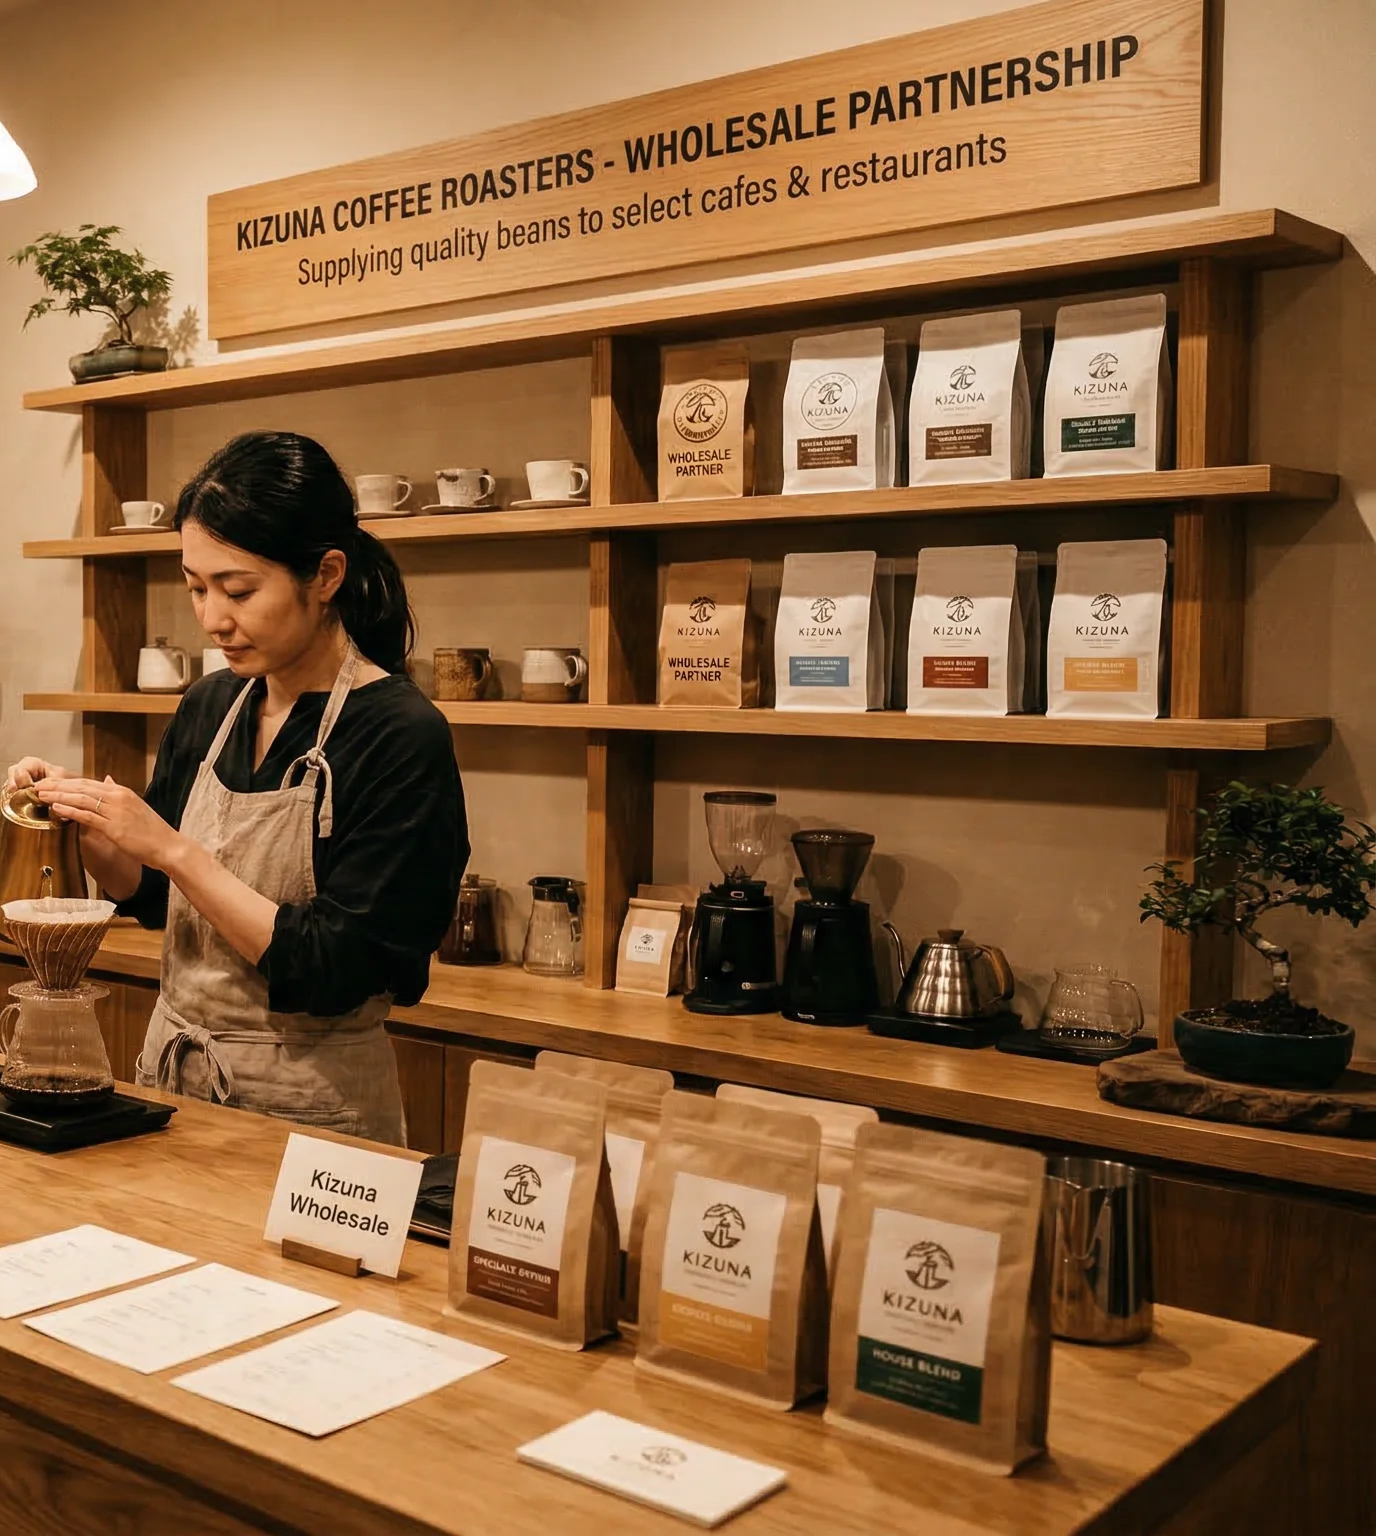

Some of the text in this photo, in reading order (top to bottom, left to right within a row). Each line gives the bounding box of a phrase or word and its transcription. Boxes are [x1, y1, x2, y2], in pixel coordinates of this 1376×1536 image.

[237, 34, 1139, 251] KIZUNA COFFEE ROASTERS - WHOLESALE PARTNERSHIP
[298, 133, 1007, 287] Supplying quality beans to select cafes & restaurants
[1074, 381, 1128, 396] KIZUNA
[667, 448, 732, 464] WHOLESALE
[676, 463, 724, 477] PARTNER
[798, 627, 843, 636] KIZUNA
[932, 626, 982, 636] KIZUNA
[1075, 626, 1129, 636] KIZUNA
[675, 670, 722, 682] PARTNER
[310, 1168, 378, 1203] Kizuna
[289, 1192, 390, 1237] Wholesale
[487, 1206, 546, 1235] KIZUNA
[682, 1249, 752, 1281] KIZUNA
[882, 1288, 964, 1326] KIZUNA
